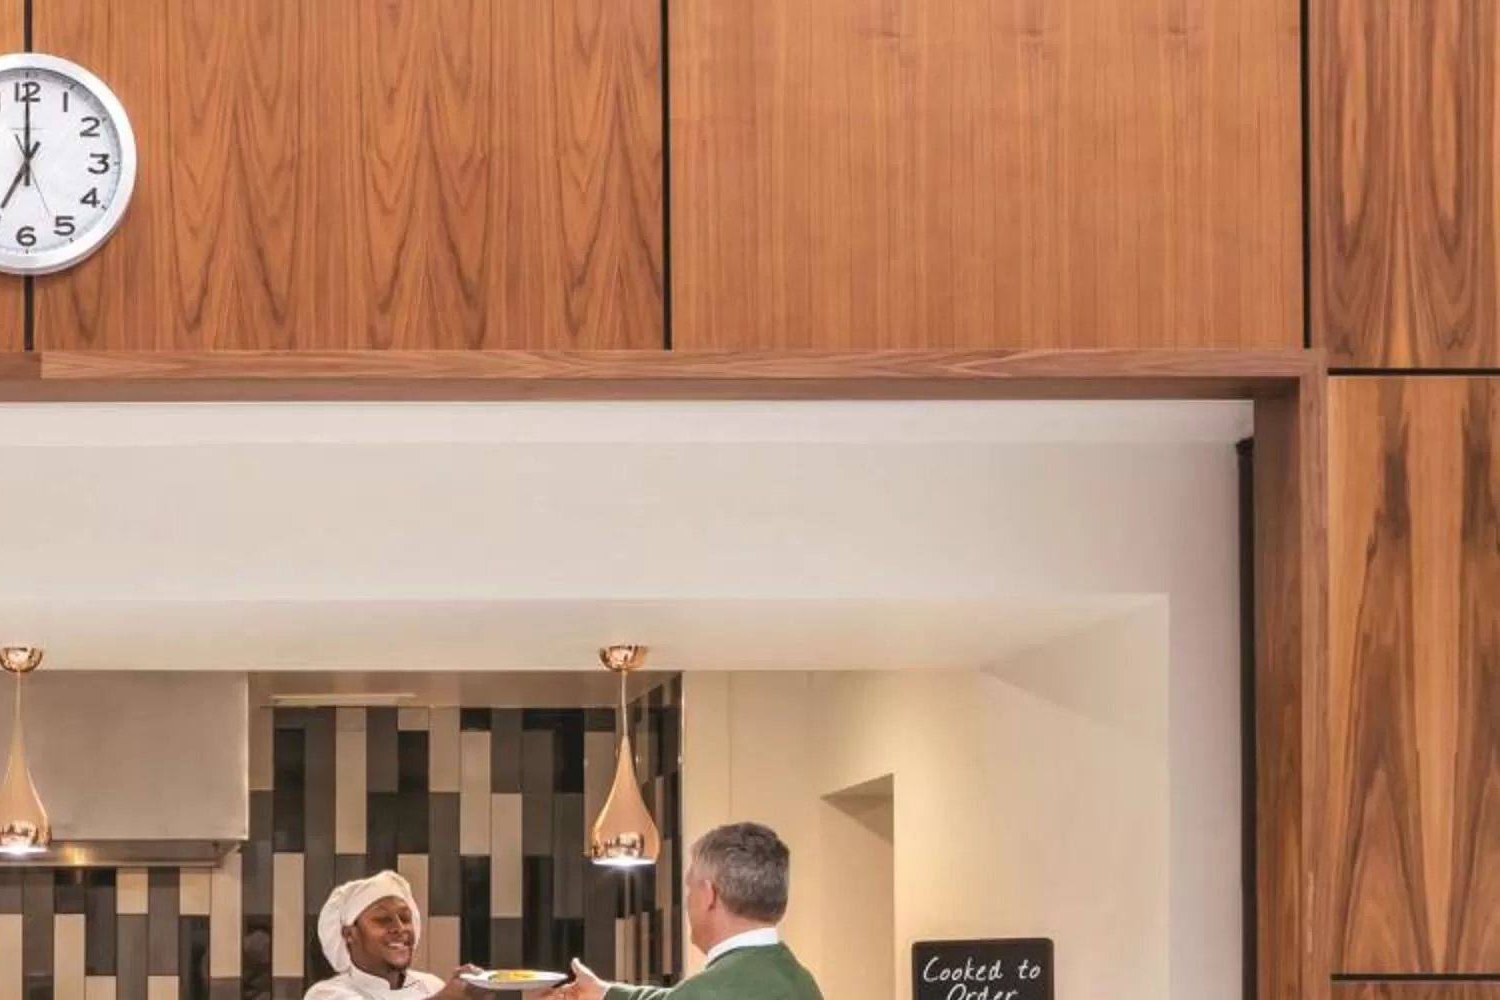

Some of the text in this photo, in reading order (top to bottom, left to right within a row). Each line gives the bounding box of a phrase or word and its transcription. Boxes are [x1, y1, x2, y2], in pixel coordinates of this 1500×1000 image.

[14, 81, 41, 102] 12
[63, 91, 69, 113] 1
[79, 116, 101, 137] 2
[88, 153, 110, 174] 3
[80, 187, 101, 208] 4
[15, 226, 37, 247] 6
[53, 215, 76, 237] 5
[923, 956, 1041, 982] Cooked to
